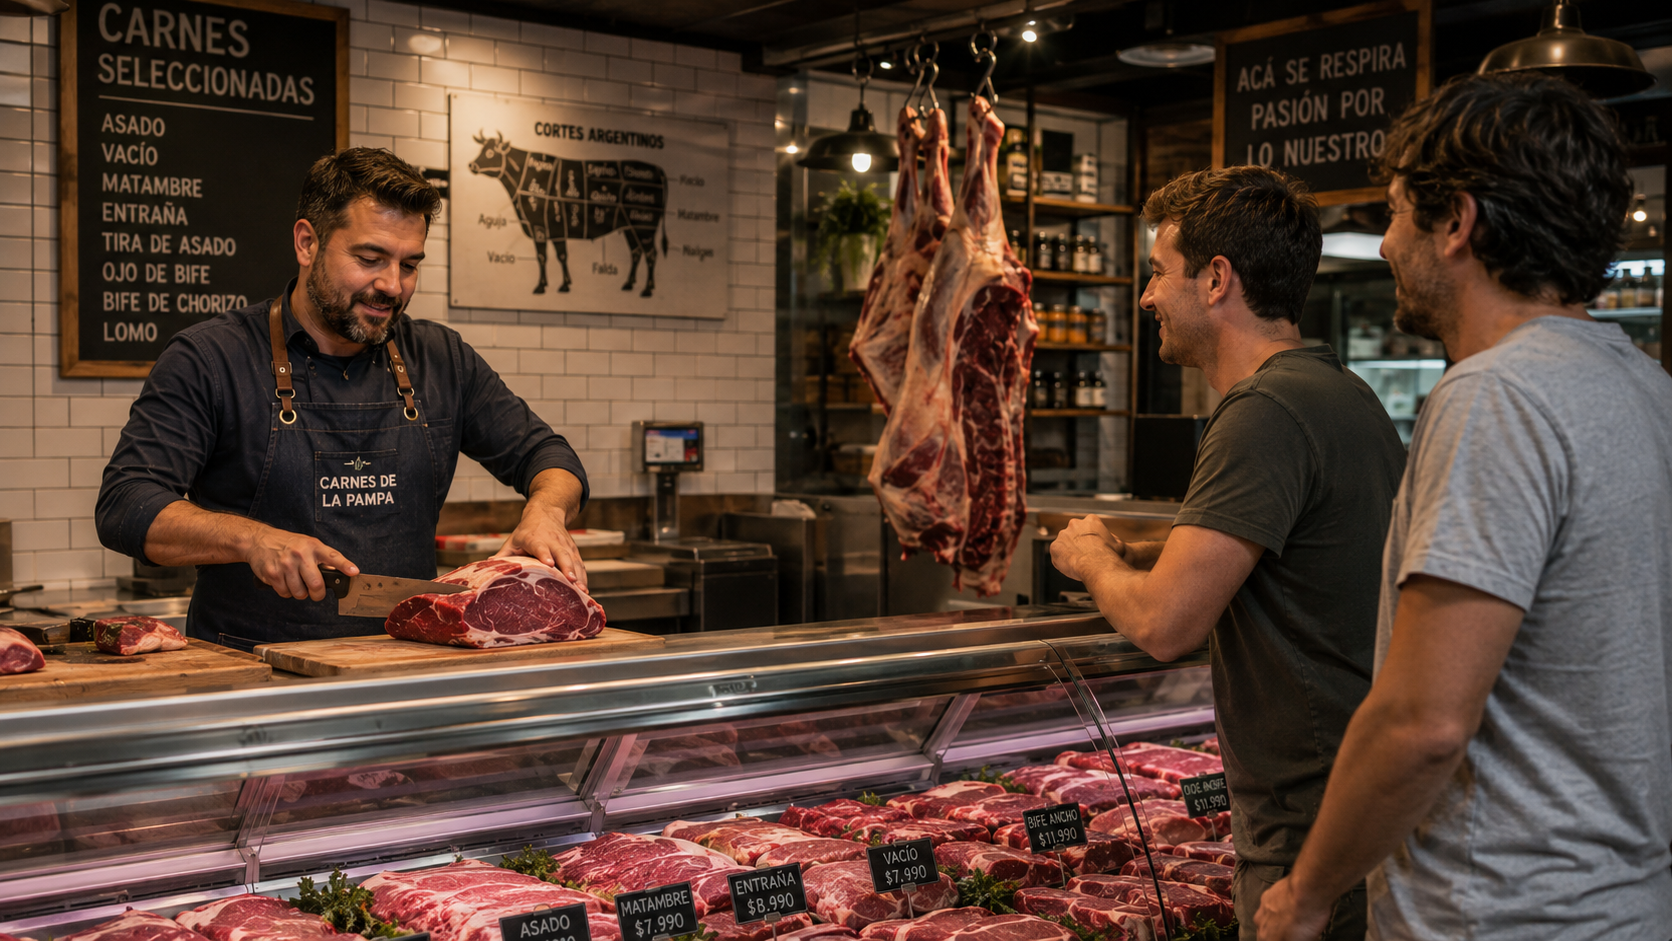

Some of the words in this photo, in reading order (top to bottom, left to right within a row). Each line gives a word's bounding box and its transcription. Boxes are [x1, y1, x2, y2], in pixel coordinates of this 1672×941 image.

[98, 2, 250, 58] CARNES
[98, 53, 315, 106] SELECCIONADAS
[1237, 56, 1276, 93] ACÁ
[1285, 57, 1310, 86] SE
[1320, 42, 1407, 80] RESPIRA
[1251, 89, 1329, 131] PASIÓN
[1341, 87, 1385, 120] POR
[101, 113, 165, 137] ASADO
[535, 121, 584, 140] CORTES
[588, 128, 665, 150] ARGENTINOS
[101, 141, 158, 166] VACÍO
[1284, 129, 1386, 168] NUESTRO
[102, 173, 203, 198] MATAMBRE
[102, 202, 188, 226] ENTRAÑA
[102, 232, 143, 253] TIRA
[150, 234, 171, 254] DE
[179, 236, 236, 257] ASADO
[102, 262, 137, 282] OJO
[145, 263, 167, 283] DE
[175, 264, 210, 284] BIFE
[103, 292, 140, 312] BIFE
[148, 293, 170, 313] DE
[177, 294, 247, 314] CHORIZO
[103, 322, 158, 342] LOMO
[319, 475, 376, 489] CARNES
[380, 474, 397, 487] DE
[322, 494, 342, 507] LA
[346, 491, 394, 506] PAMPA
[1194, 794, 1227, 812] $11.990
[1027, 814, 1048, 829] BIFE
[1049, 809, 1078, 825] ANCHO
[1038, 827, 1077, 847] $11.990
[883, 844, 919, 863] VACÍO
[735, 870, 797, 896] ENTRAÑA
[885, 864, 927, 885] $7.990
[620, 889, 690, 916] MATAMBRE
[747, 892, 795, 915] $8.990
[520, 914, 570, 938] ASADO
[634, 912, 685, 939] $7.990
